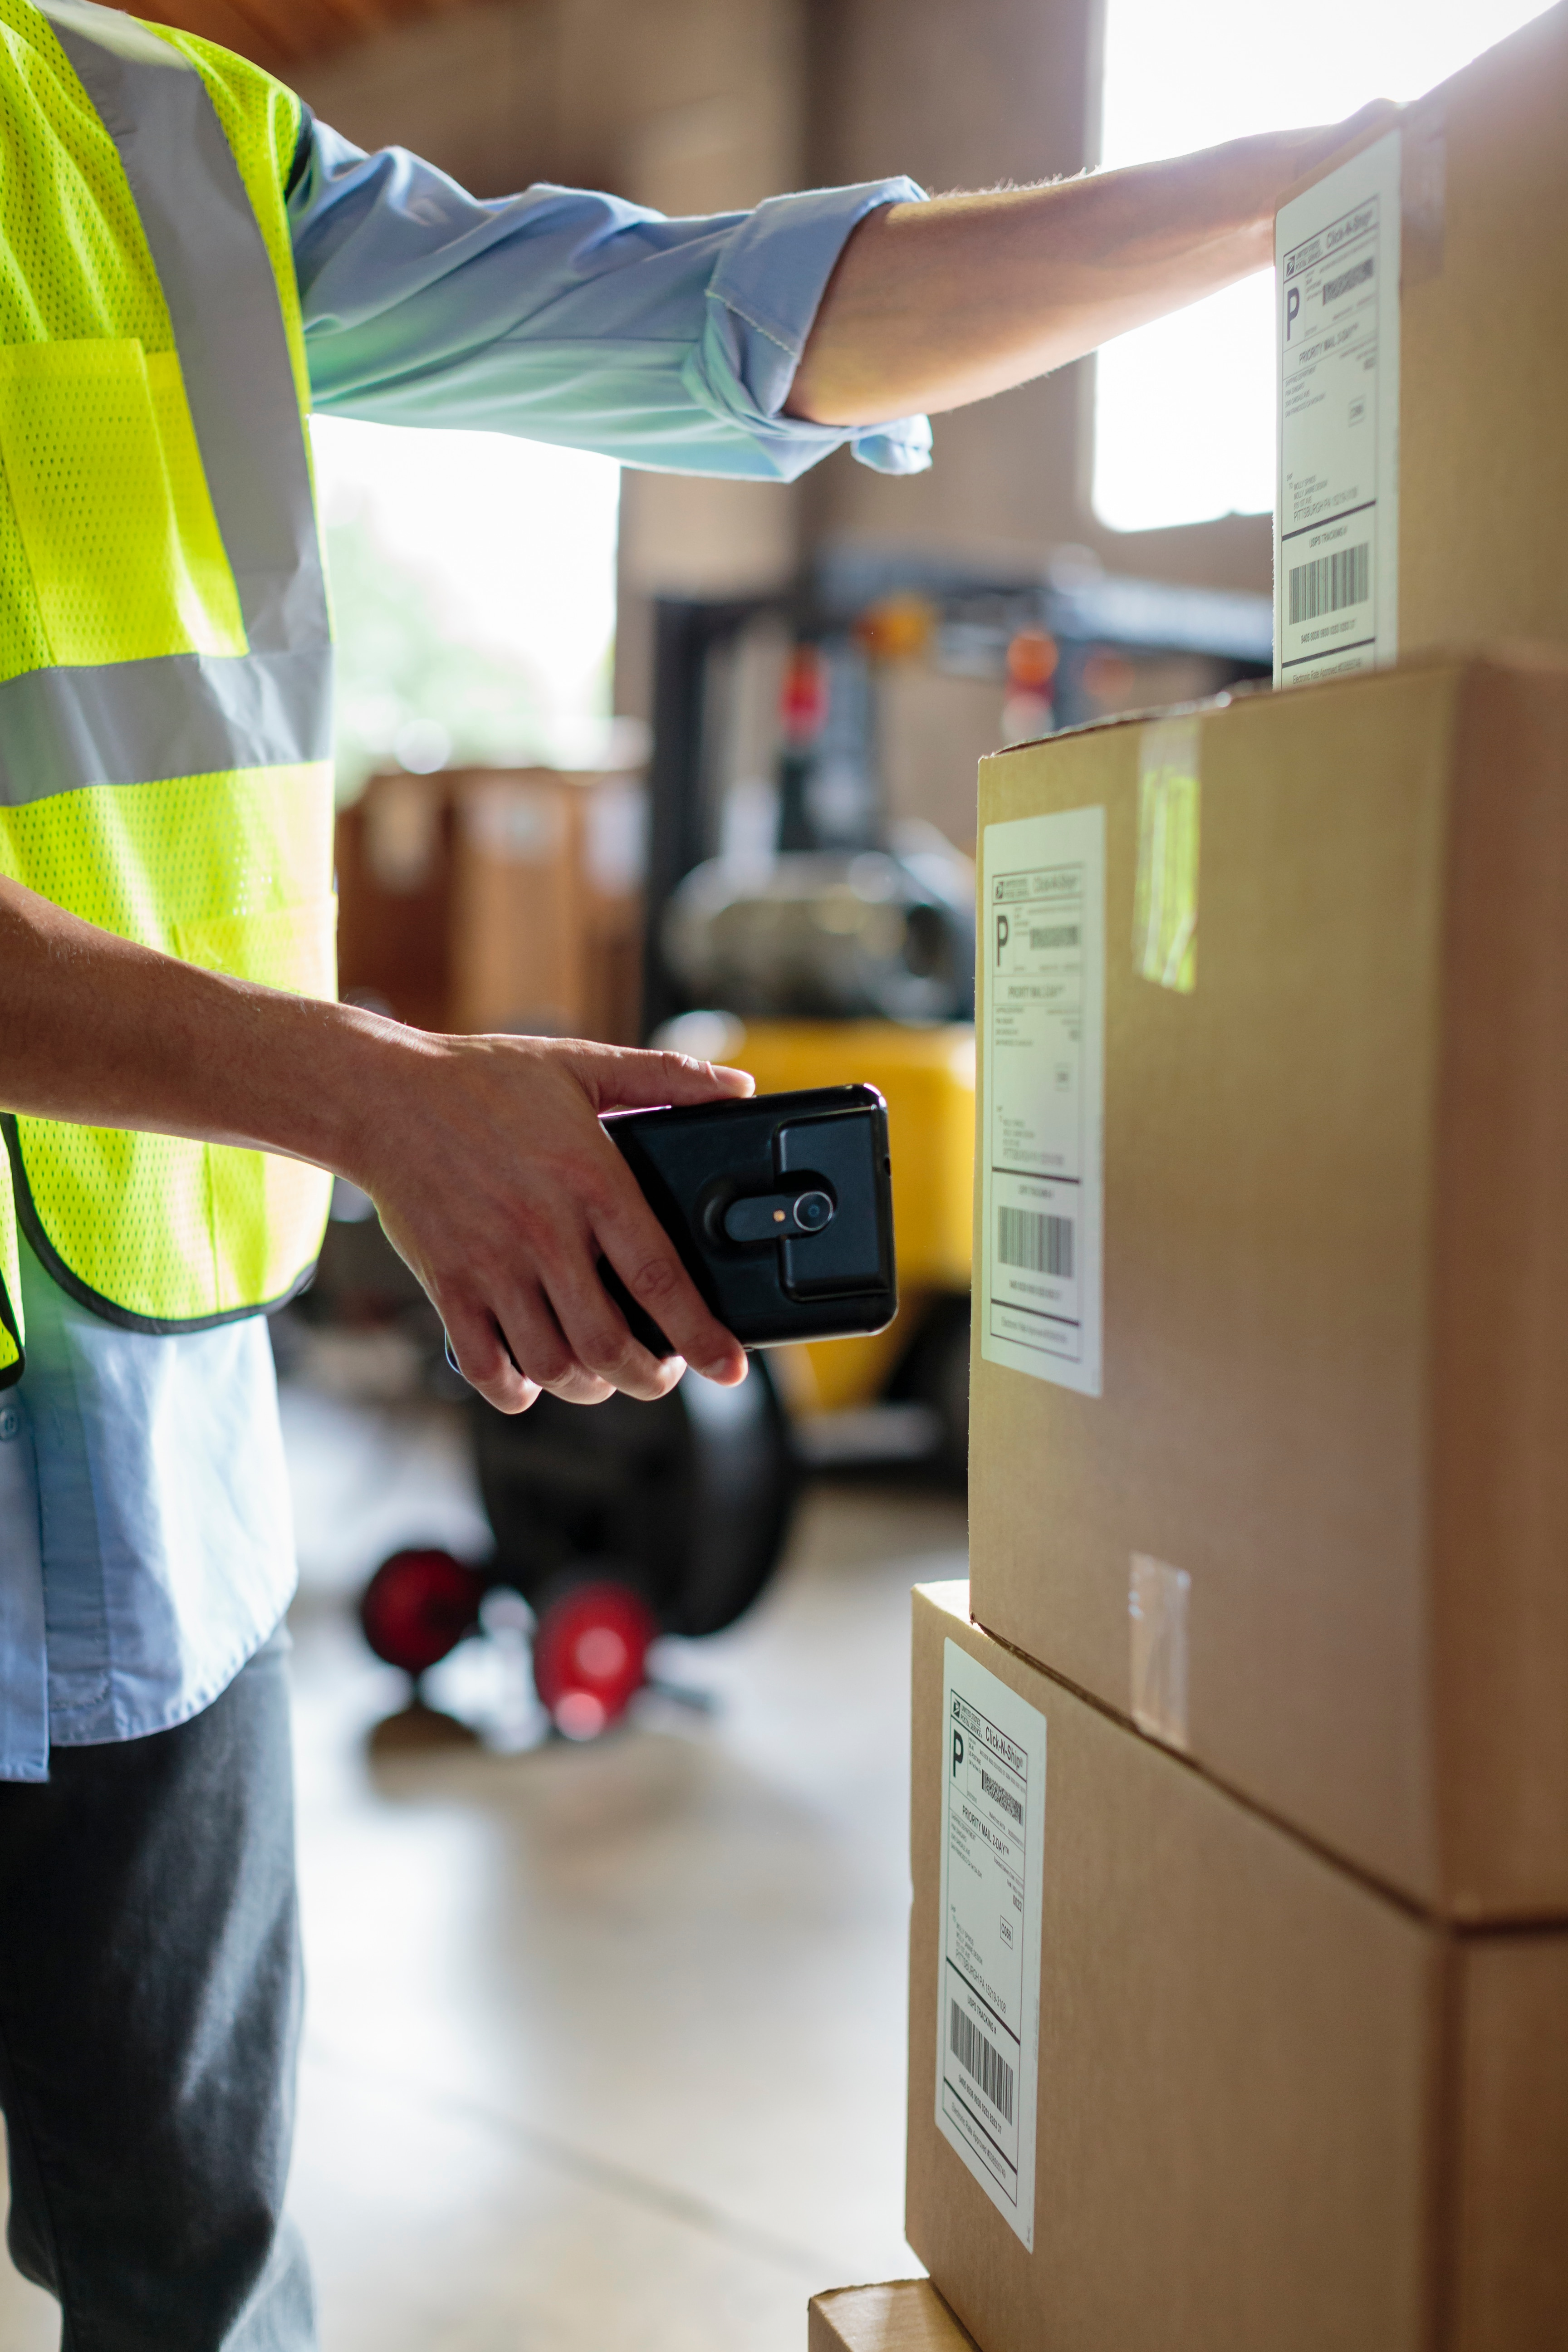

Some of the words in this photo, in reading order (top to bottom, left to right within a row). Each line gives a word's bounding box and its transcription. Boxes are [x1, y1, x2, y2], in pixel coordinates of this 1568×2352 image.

[1287, 286, 1300, 341] P
[1299, 341, 1323, 365] PRIORITY
[1294, 500, 1323, 523] PITTSBURGH
[1309, 534, 1321, 549] USPS
[1293, 671, 1310, 685] Electronic
[1310, 668, 1319, 680] Rate
[997, 915, 1008, 967] P
[971, 1711, 980, 1727] STATES
[953, 1730, 964, 1778] P
[962, 1803, 981, 1833] PRIORITY
[981, 1822, 991, 1844] MAIL
[1012, 1893, 1022, 1914] 0022
[1001, 1921, 1011, 1943] C056
[979, 1974, 985, 1991] PA
[985, 1981, 1006, 2015] 15219-3108
[976, 2004, 994, 2034] TRACKING
[989, 2111, 997, 2131] 8253
[997, 2122, 1002, 2136] 37
